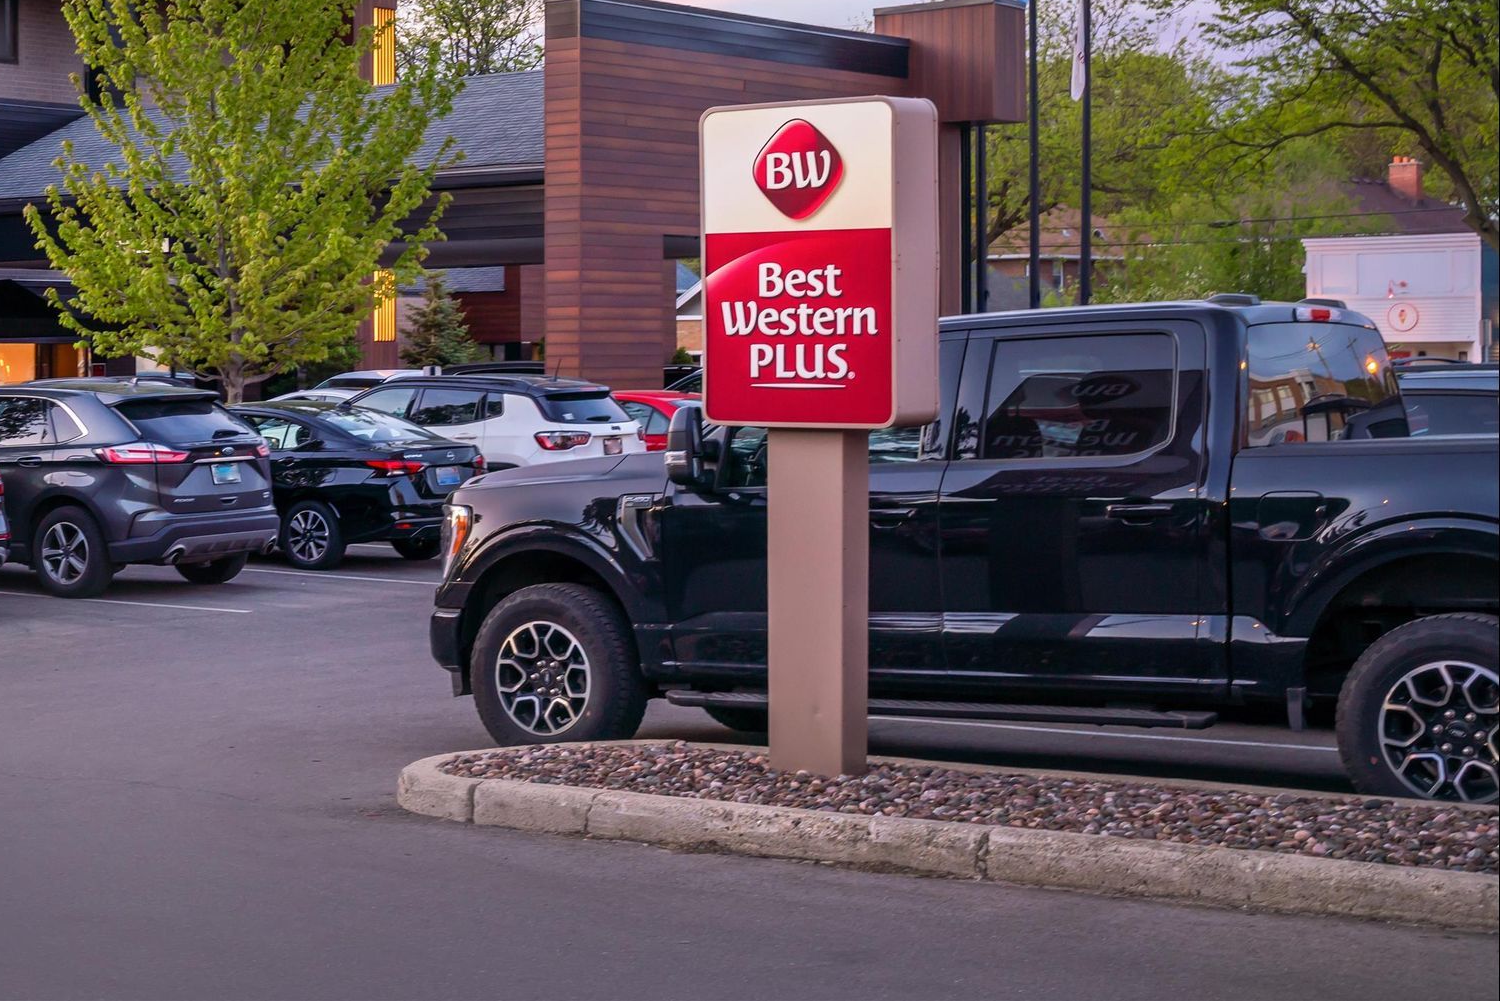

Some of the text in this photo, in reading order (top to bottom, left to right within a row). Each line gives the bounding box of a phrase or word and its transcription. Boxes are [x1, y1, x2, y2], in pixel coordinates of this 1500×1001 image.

[766, 149, 831, 190] BW
[758, 262, 843, 298] Best
[721, 300, 879, 336] Western
[750, 343, 849, 380] PLUS
